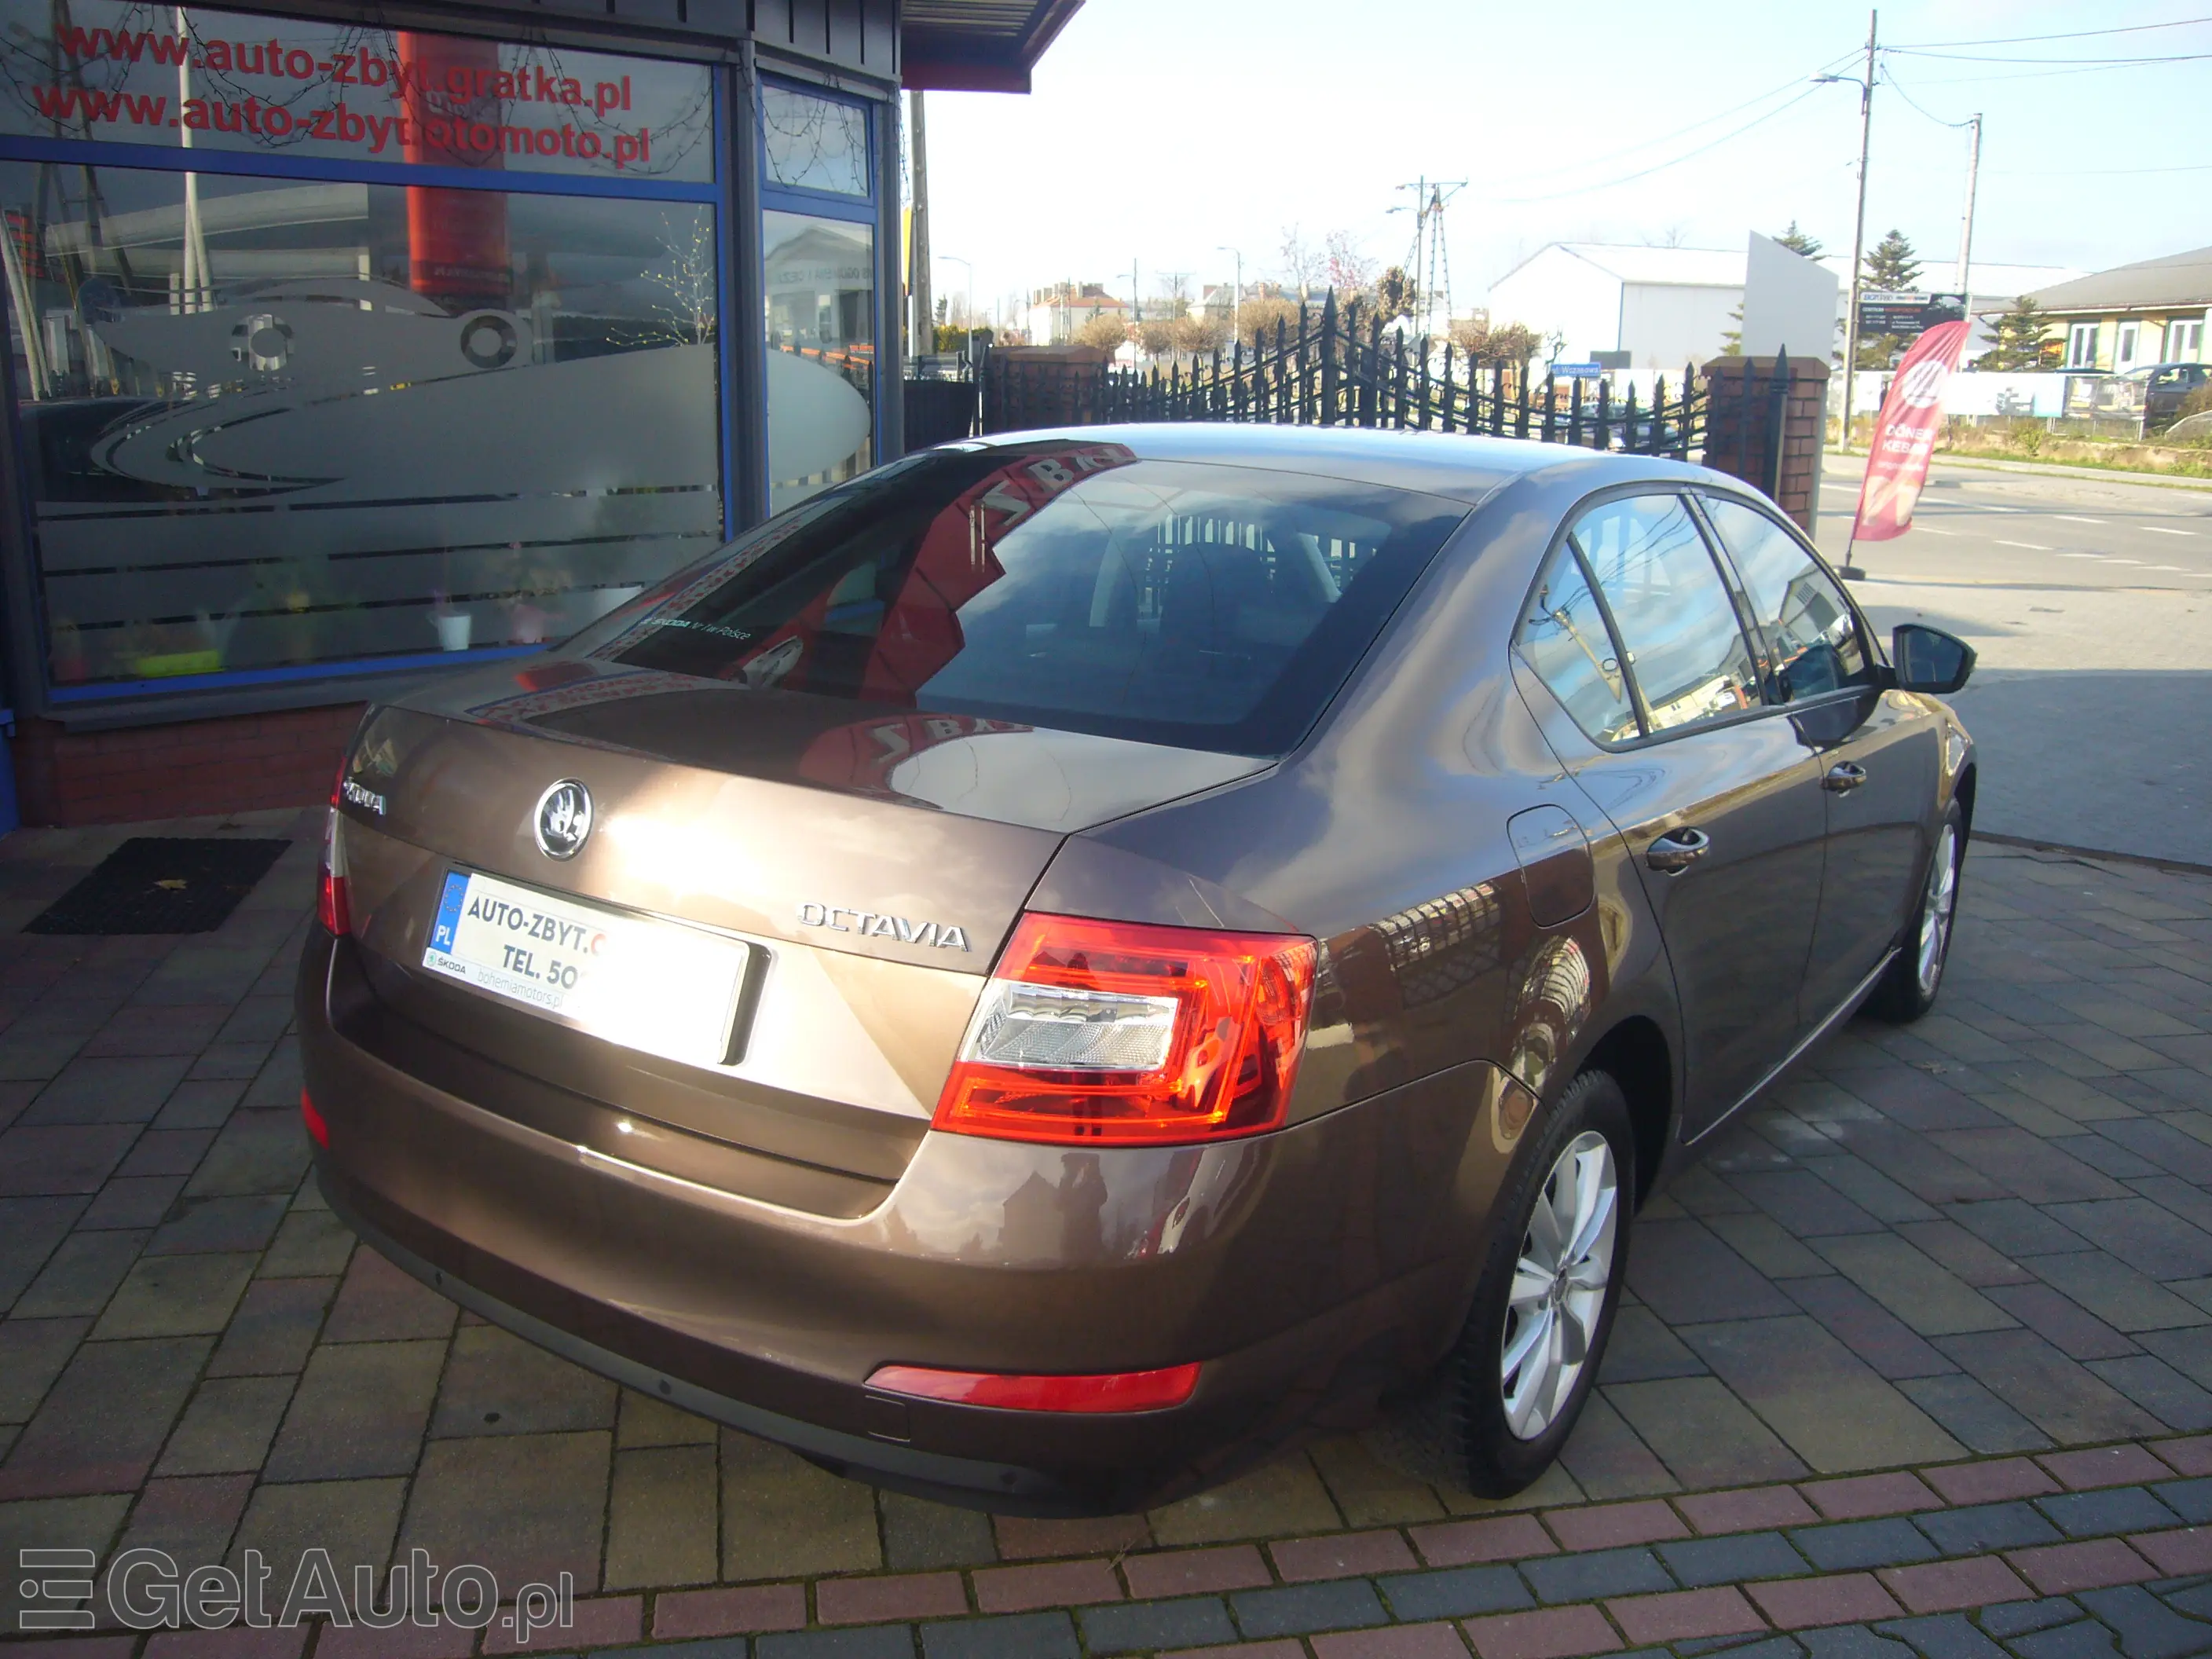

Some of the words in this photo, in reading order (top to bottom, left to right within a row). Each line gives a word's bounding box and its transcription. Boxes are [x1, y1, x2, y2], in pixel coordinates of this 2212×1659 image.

[55, 23, 632, 117] www.auto-zbyt.gratka.pl
[1882, 439, 1929, 456] KEB
[1885, 423, 1933, 441] DÖNE
[436, 924, 451, 946] PL
[795, 903, 971, 953] OCTAVIA
[503, 943, 540, 980] TEL.
[477, 967, 564, 1011] bohemiamotors.pl
